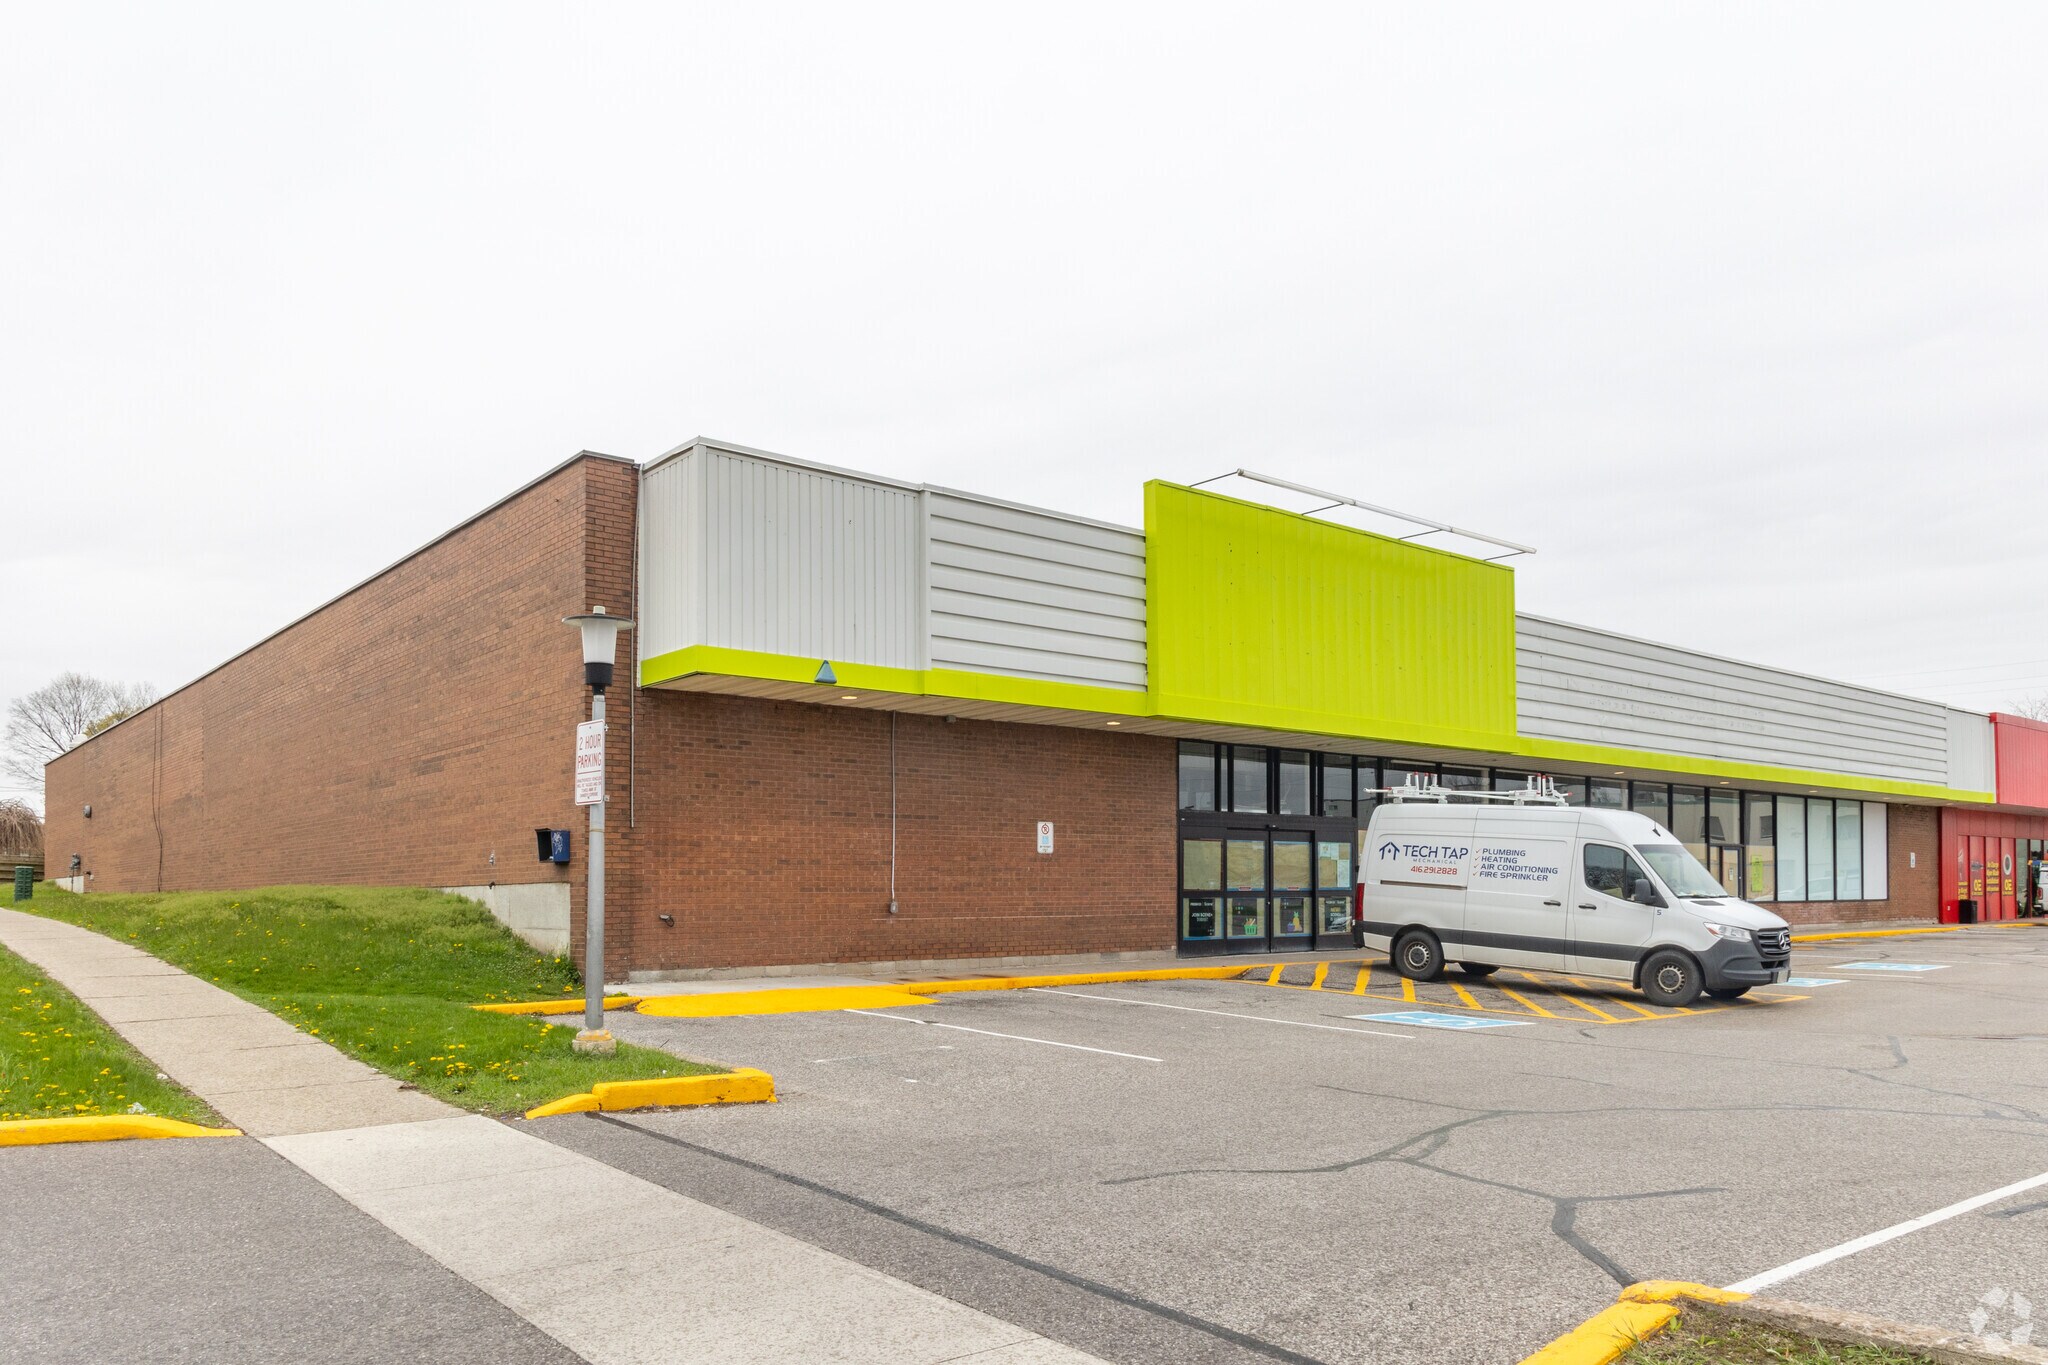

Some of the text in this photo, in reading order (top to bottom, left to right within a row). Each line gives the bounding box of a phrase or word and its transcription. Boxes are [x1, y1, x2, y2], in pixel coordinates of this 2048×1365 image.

[579, 734, 601, 750] 2 HOUR
[578, 752, 601, 769] PARKING
[1403, 845, 1468, 859] TECH TAP
[1482, 848, 1526, 857] PLUMBING
[1481, 855, 1518, 864] HEATING
[1496, 864, 1559, 874] CONDITIONING
[1479, 870, 1548, 881] FIRE SPRINKLER
